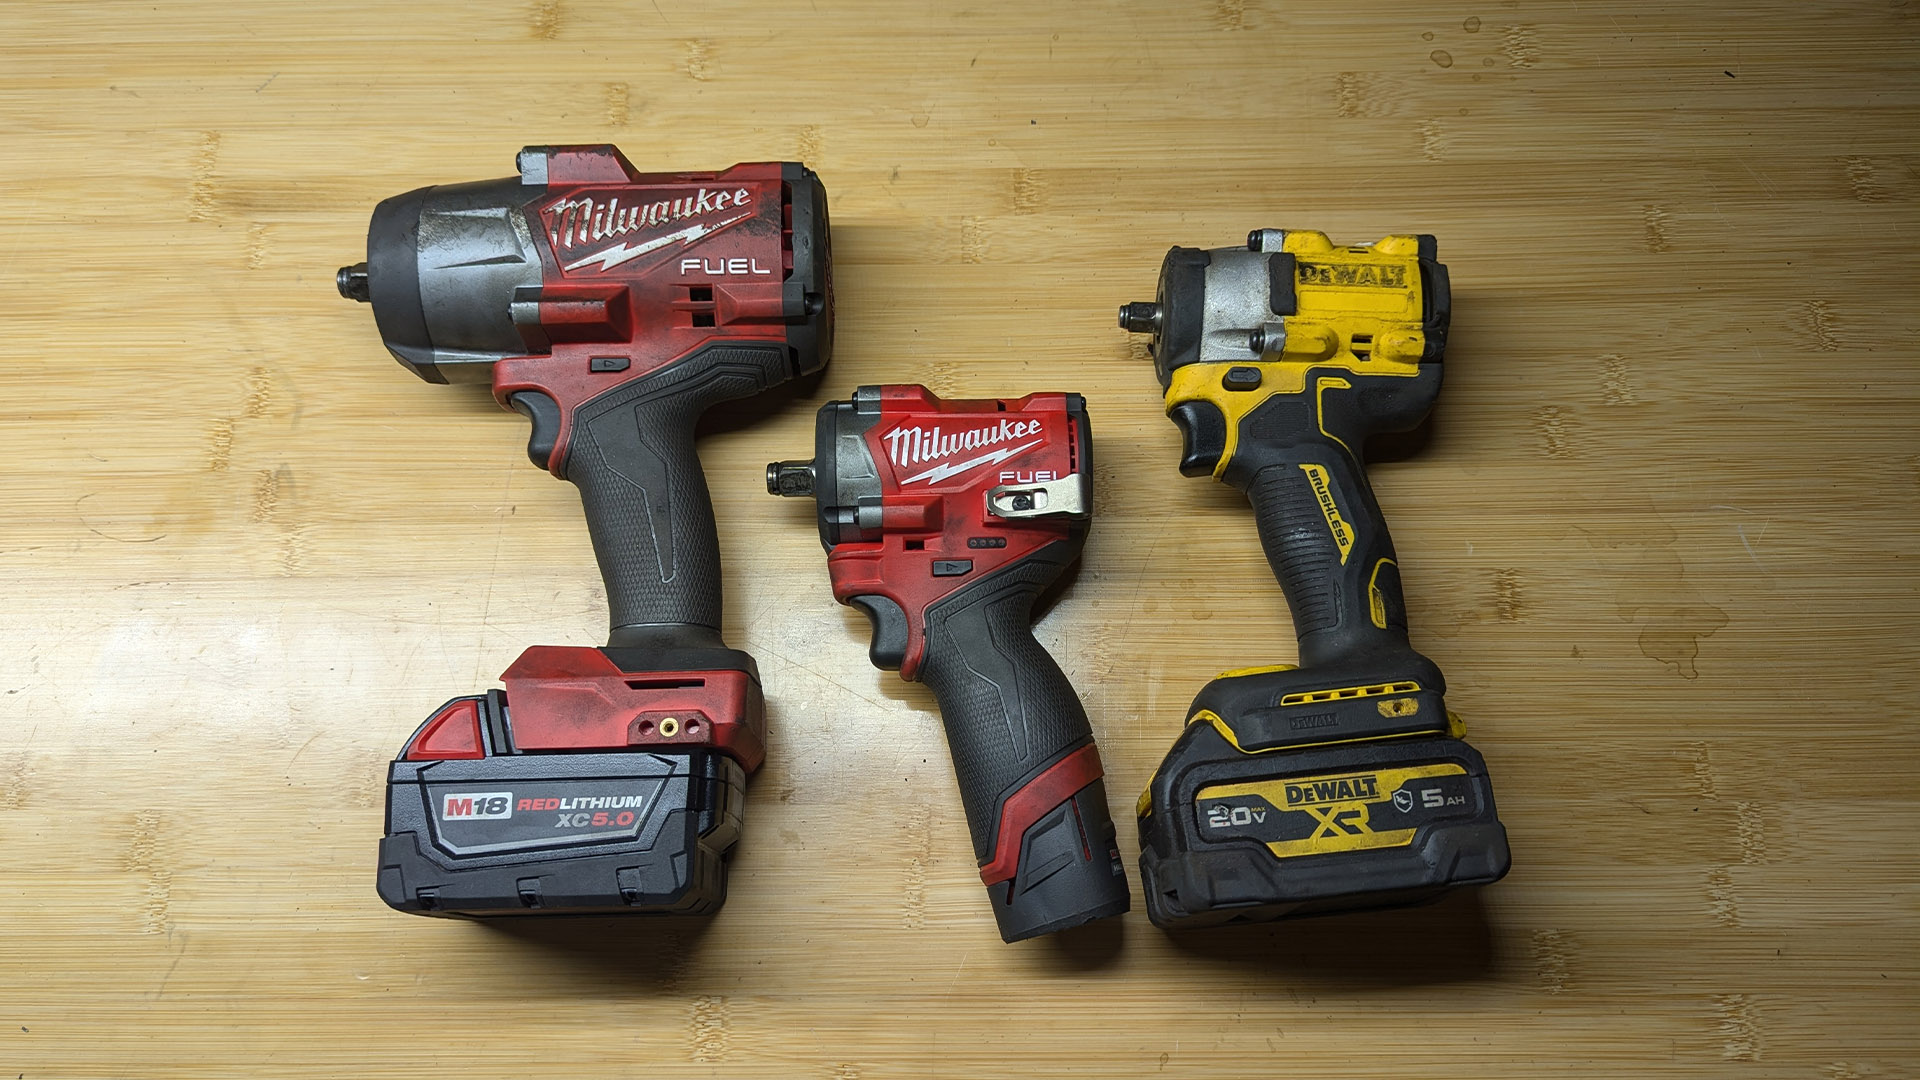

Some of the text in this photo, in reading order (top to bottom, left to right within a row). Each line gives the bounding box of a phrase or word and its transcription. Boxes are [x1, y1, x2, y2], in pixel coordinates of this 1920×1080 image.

[544, 187, 751, 248] Milwaukee
[680, 258, 771, 275] FUEL
[884, 419, 1043, 467] Milwaukee
[1309, 469, 1349, 546] BRUSHLESS
[447, 796, 642, 816] M18 REDLITHIUM
[1286, 778, 1379, 803] DEWALT
[1308, 803, 1373, 838] XR
